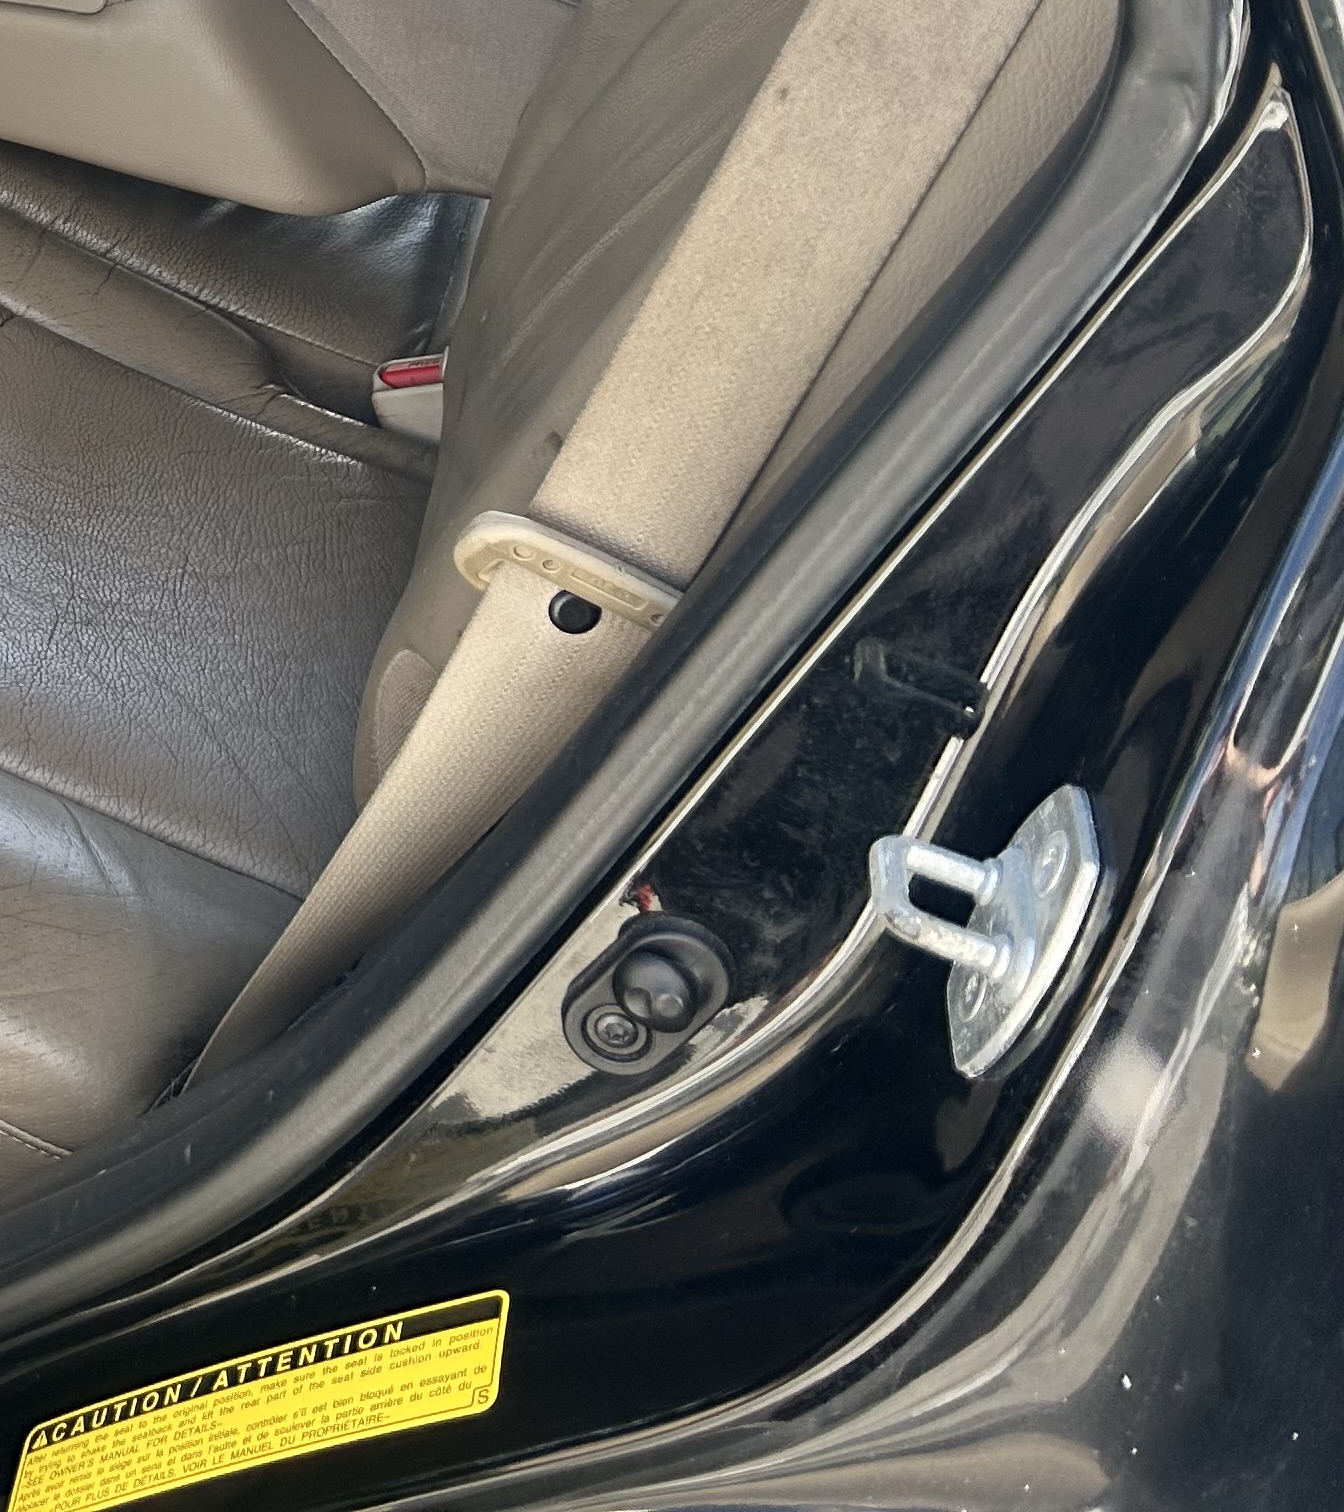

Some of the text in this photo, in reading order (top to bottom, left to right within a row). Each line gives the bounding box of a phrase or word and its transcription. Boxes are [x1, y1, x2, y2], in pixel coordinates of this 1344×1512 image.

[52, 1383, 181, 1442] CAUTION
[212, 1321, 403, 1391] ATTENTION
[67, 1454, 75, 1463] to
[112, 1437, 126, 1448] the
[178, 1415, 196, 1427] and
[219, 1404, 234, 1415] the
[240, 1397, 260, 1409] rear
[266, 1390, 286, 1404] part
[292, 1384, 303, 1394] of
[309, 1379, 324, 1390] the
[360, 1363, 382, 1377] side
[388, 1351, 431, 1370] cushion
[94, 1432, 108, 1442] the
[138, 1419, 147, 1428] to
[153, 1413, 167, 1424] the
[172, 1400, 207, 1419] original
[213, 1387, 253, 1408] position,
[260, 1377, 287, 1392] make
[293, 1370, 315, 1383] sure
[322, 1364, 338, 1375] the
[374, 1352, 383, 1361] is
[390, 1341, 425, 1358] locked
[431, 1337, 441, 1347] in
[448, 1324, 493, 1345] position
[156, 1447, 163, 1457] la
[168, 1437, 203, 1455] position
[311, 1402, 326, 1413] est
[360, 1384, 393, 1403] bloqué
[400, 1382, 413, 1391] en
[419, 1368, 467, 1388] essayant
[473, 1363, 487, 1374] de
[180, 1448, 202, 1462] dans
[256, 1430, 268, 1441] de
[274, 1417, 316, 1436] soulever
[321, 1413, 329, 1423] la
[336, 1406, 363, 1421] partie
[370, 1395, 403, 1412] arrière
[409, 1390, 422, 1402] du
[429, 1384, 451, 1398] côté
[458, 1379, 471, 1391] du
[478, 1388, 488, 1404] S
[48, 1457, 93, 1480] OWNER'S
[100, 1443, 138, 1463] MANUAL
[146, 1434, 167, 1449] FOR
[85, 1486, 110, 1503] PLUS
[114, 1481, 128, 1493] DE
[183, 1458, 207, 1473] VOIR
[212, 1453, 224, 1465] LE
[230, 1439, 273, 1460] MANUEL
[280, 1434, 295, 1446] DU
